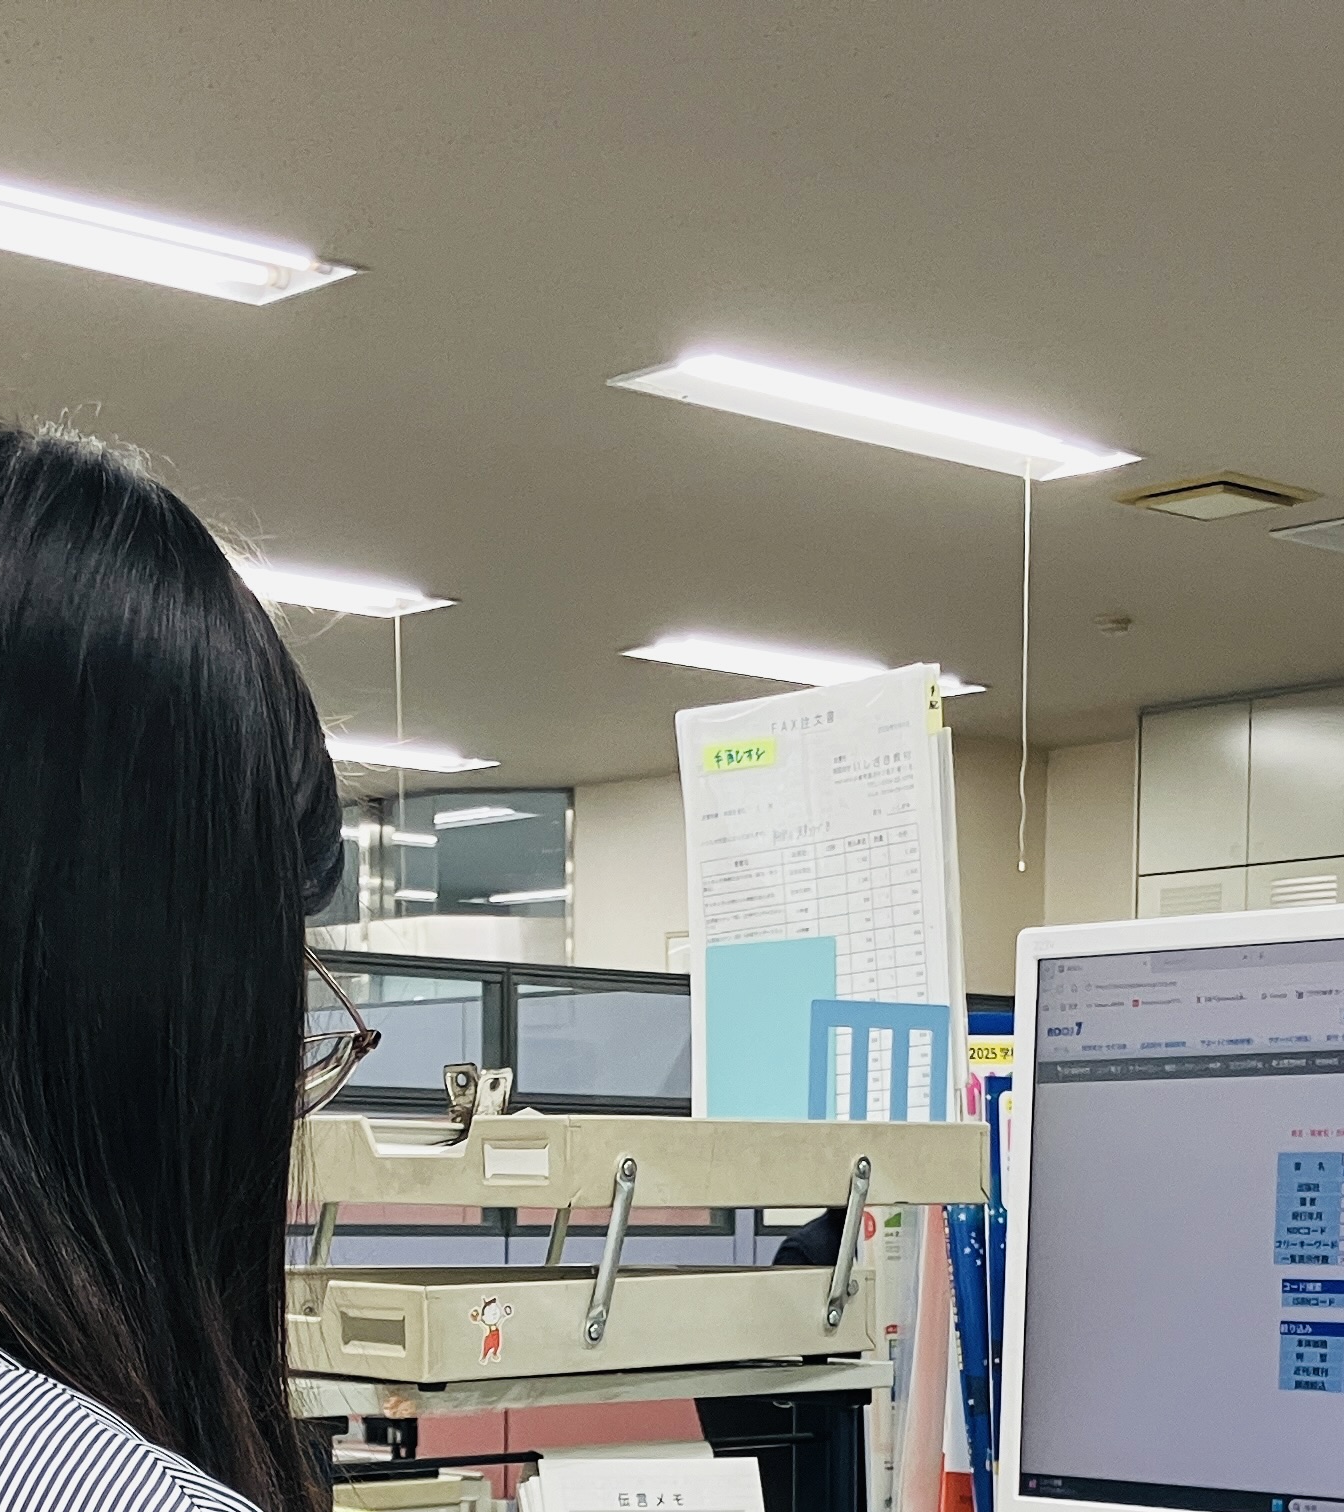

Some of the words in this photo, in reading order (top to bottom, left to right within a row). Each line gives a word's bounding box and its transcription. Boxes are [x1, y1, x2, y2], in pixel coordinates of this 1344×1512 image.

[969, 1047, 998, 1060] 2025
[617, 1493, 684, 1508] 伝言メモ
